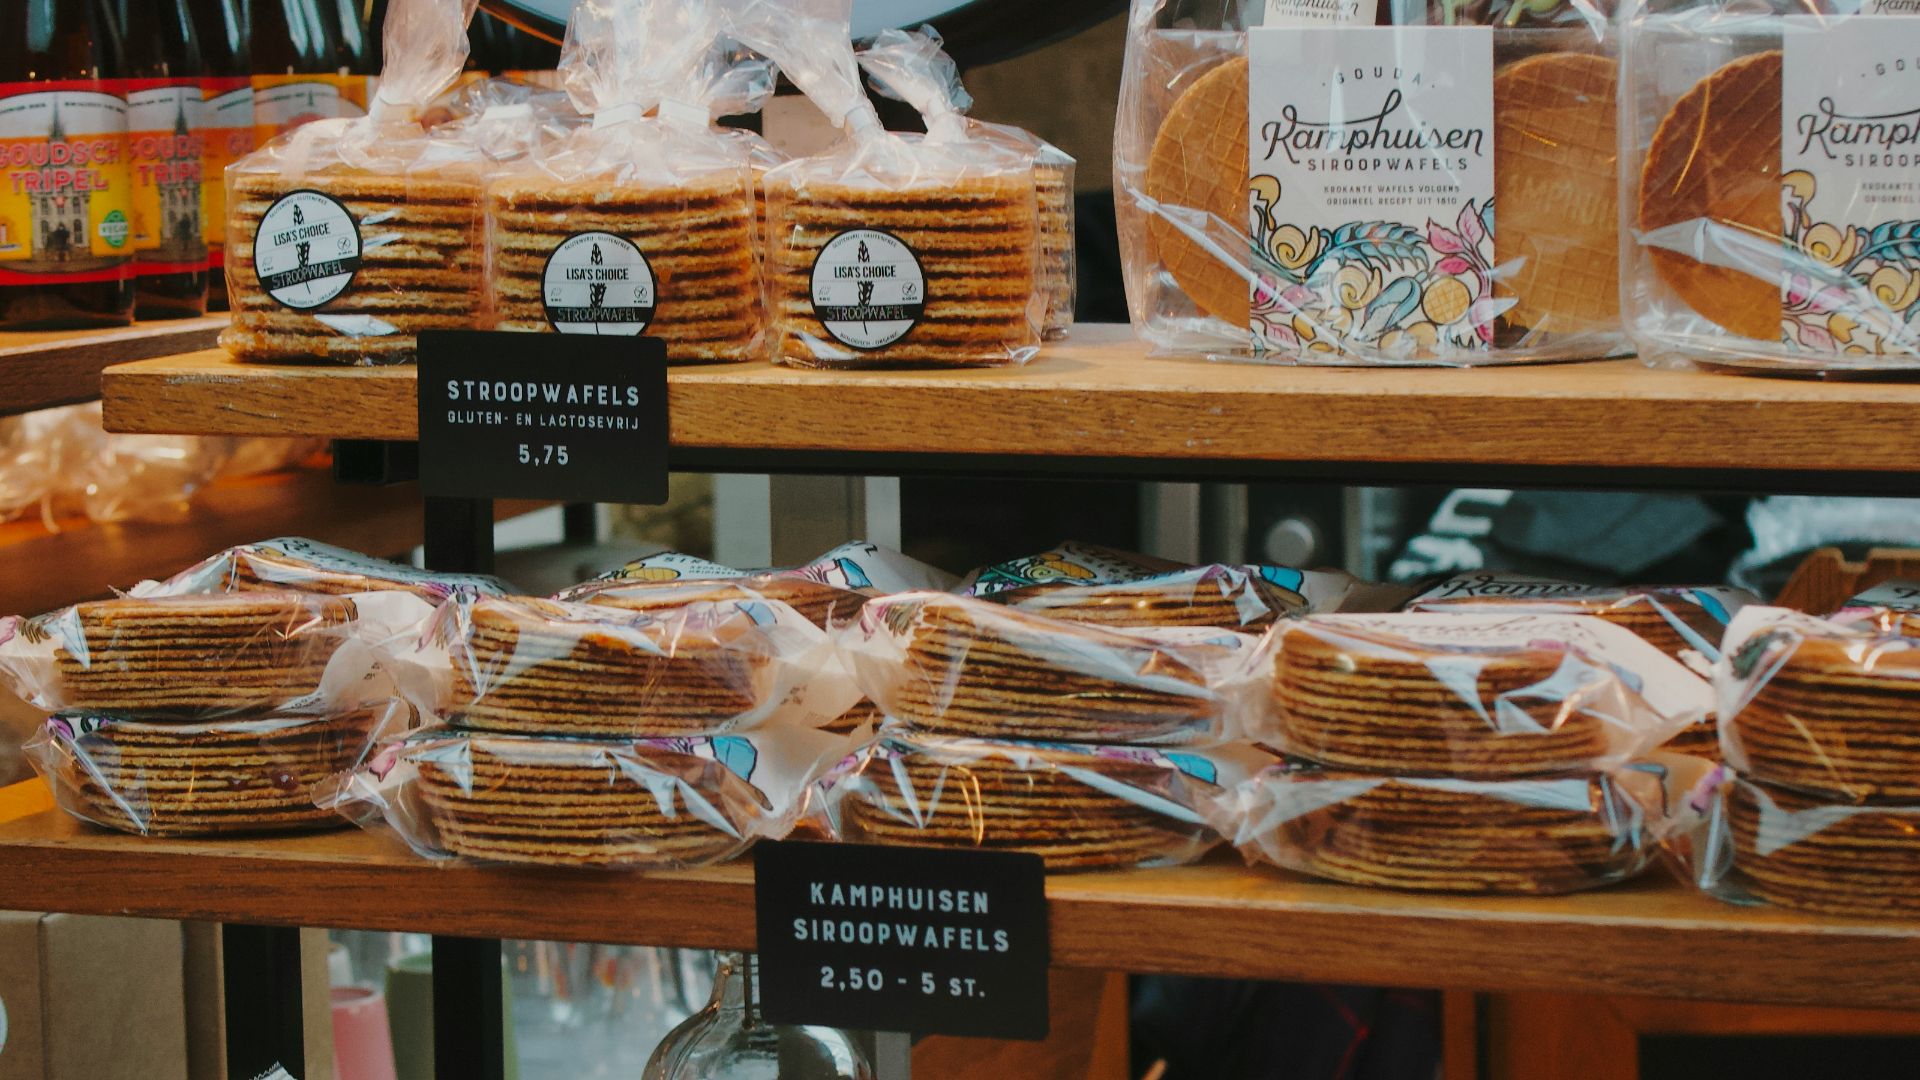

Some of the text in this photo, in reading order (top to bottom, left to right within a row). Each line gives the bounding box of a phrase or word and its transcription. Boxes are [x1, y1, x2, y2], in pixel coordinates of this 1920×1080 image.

[1336, 66, 1423, 86] GOUDA
[1262, 89, 1483, 164] Kamphuisen
[1307, 157, 1468, 172] SIROOPWAFELS
[9, 168, 109, 194] TRIPEL
[1377, 185, 1414, 194] WAFELS
[1416, 197, 1433, 206] UIT
[273, 222, 331, 247] LISA'S CHOICE
[271, 260, 346, 289] STROOPWAFEL
[566, 267, 630, 281] LISA'S CHOICE
[834, 265, 897, 279] LISA'S CHOICE
[557, 307, 640, 322] STROOPWAFEL
[826, 305, 908, 321] STROOPWAFEL
[447, 379, 640, 407] STROOPWAFELS
[447, 410, 640, 430] GLUTEN- EN LACTOSEVRIJ
[518, 444, 569, 466] 5,75
[810, 882, 989, 914] KAMPHUISEN
[793, 918, 1010, 952] SIROOPWAFELS
[820, 966, 884, 991] 2,50
[921, 972, 936, 995] 5
[949, 978, 986, 998] ST.
